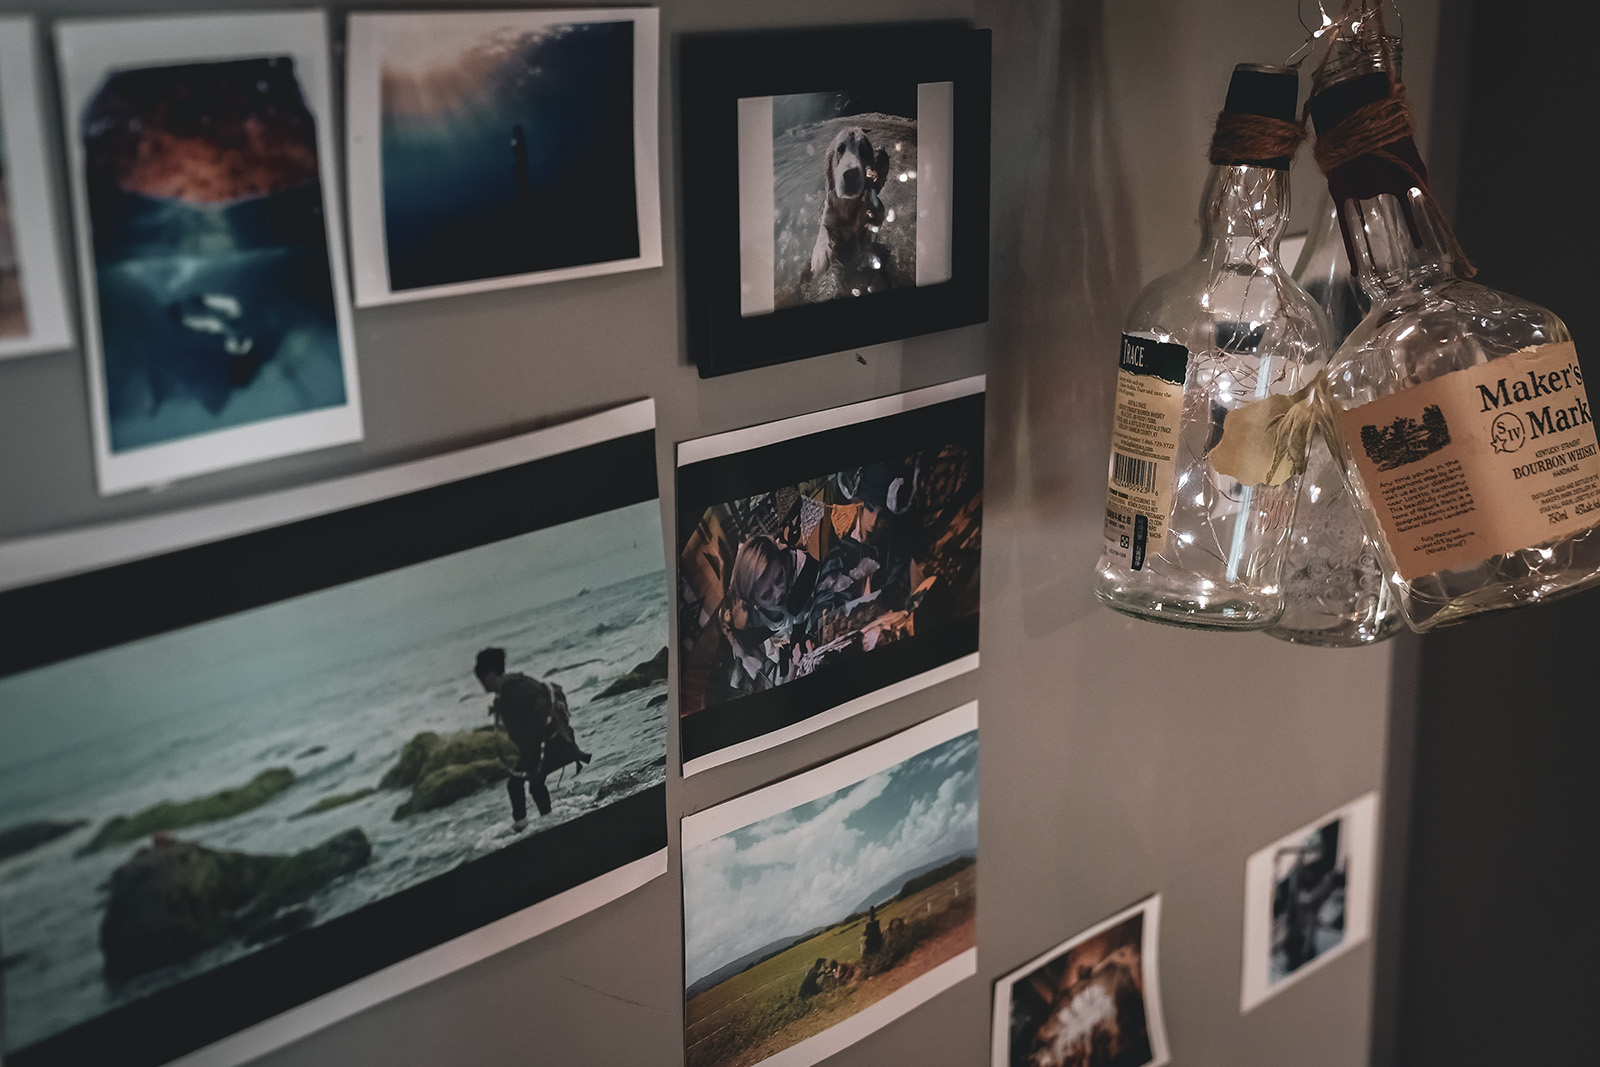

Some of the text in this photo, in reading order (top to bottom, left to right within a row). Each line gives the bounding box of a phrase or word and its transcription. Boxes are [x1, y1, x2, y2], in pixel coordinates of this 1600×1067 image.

[1123, 338, 1145, 368] TRACE
[1475, 362, 1583, 413] Maker's
[1525, 398, 1592, 440] Mark
[1394, 475, 1409, 483] time
[1512, 443, 1598, 480] BOURBON WHISKY
